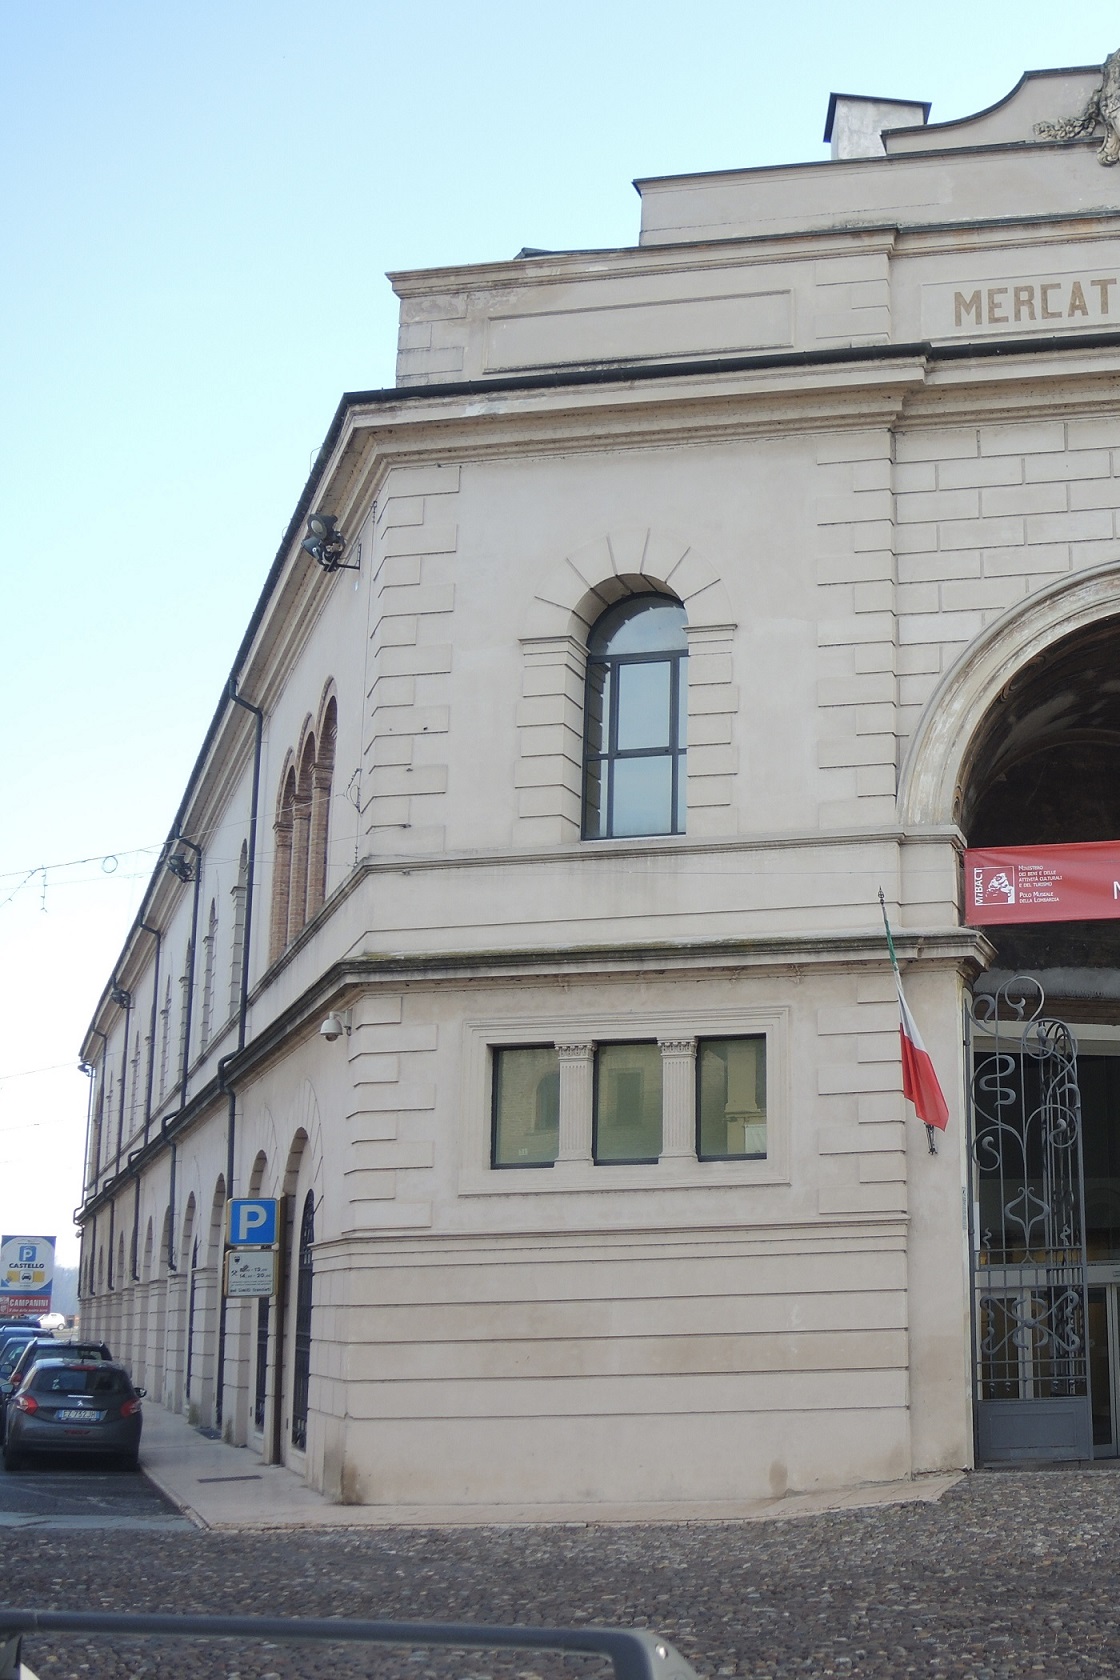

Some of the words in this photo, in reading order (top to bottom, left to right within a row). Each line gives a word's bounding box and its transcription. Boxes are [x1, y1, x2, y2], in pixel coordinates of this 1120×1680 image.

[239, 1205, 267, 1239] P
[23, 1248, 33, 1260] P
[9, 1299, 49, 1307] CAMPANINI
